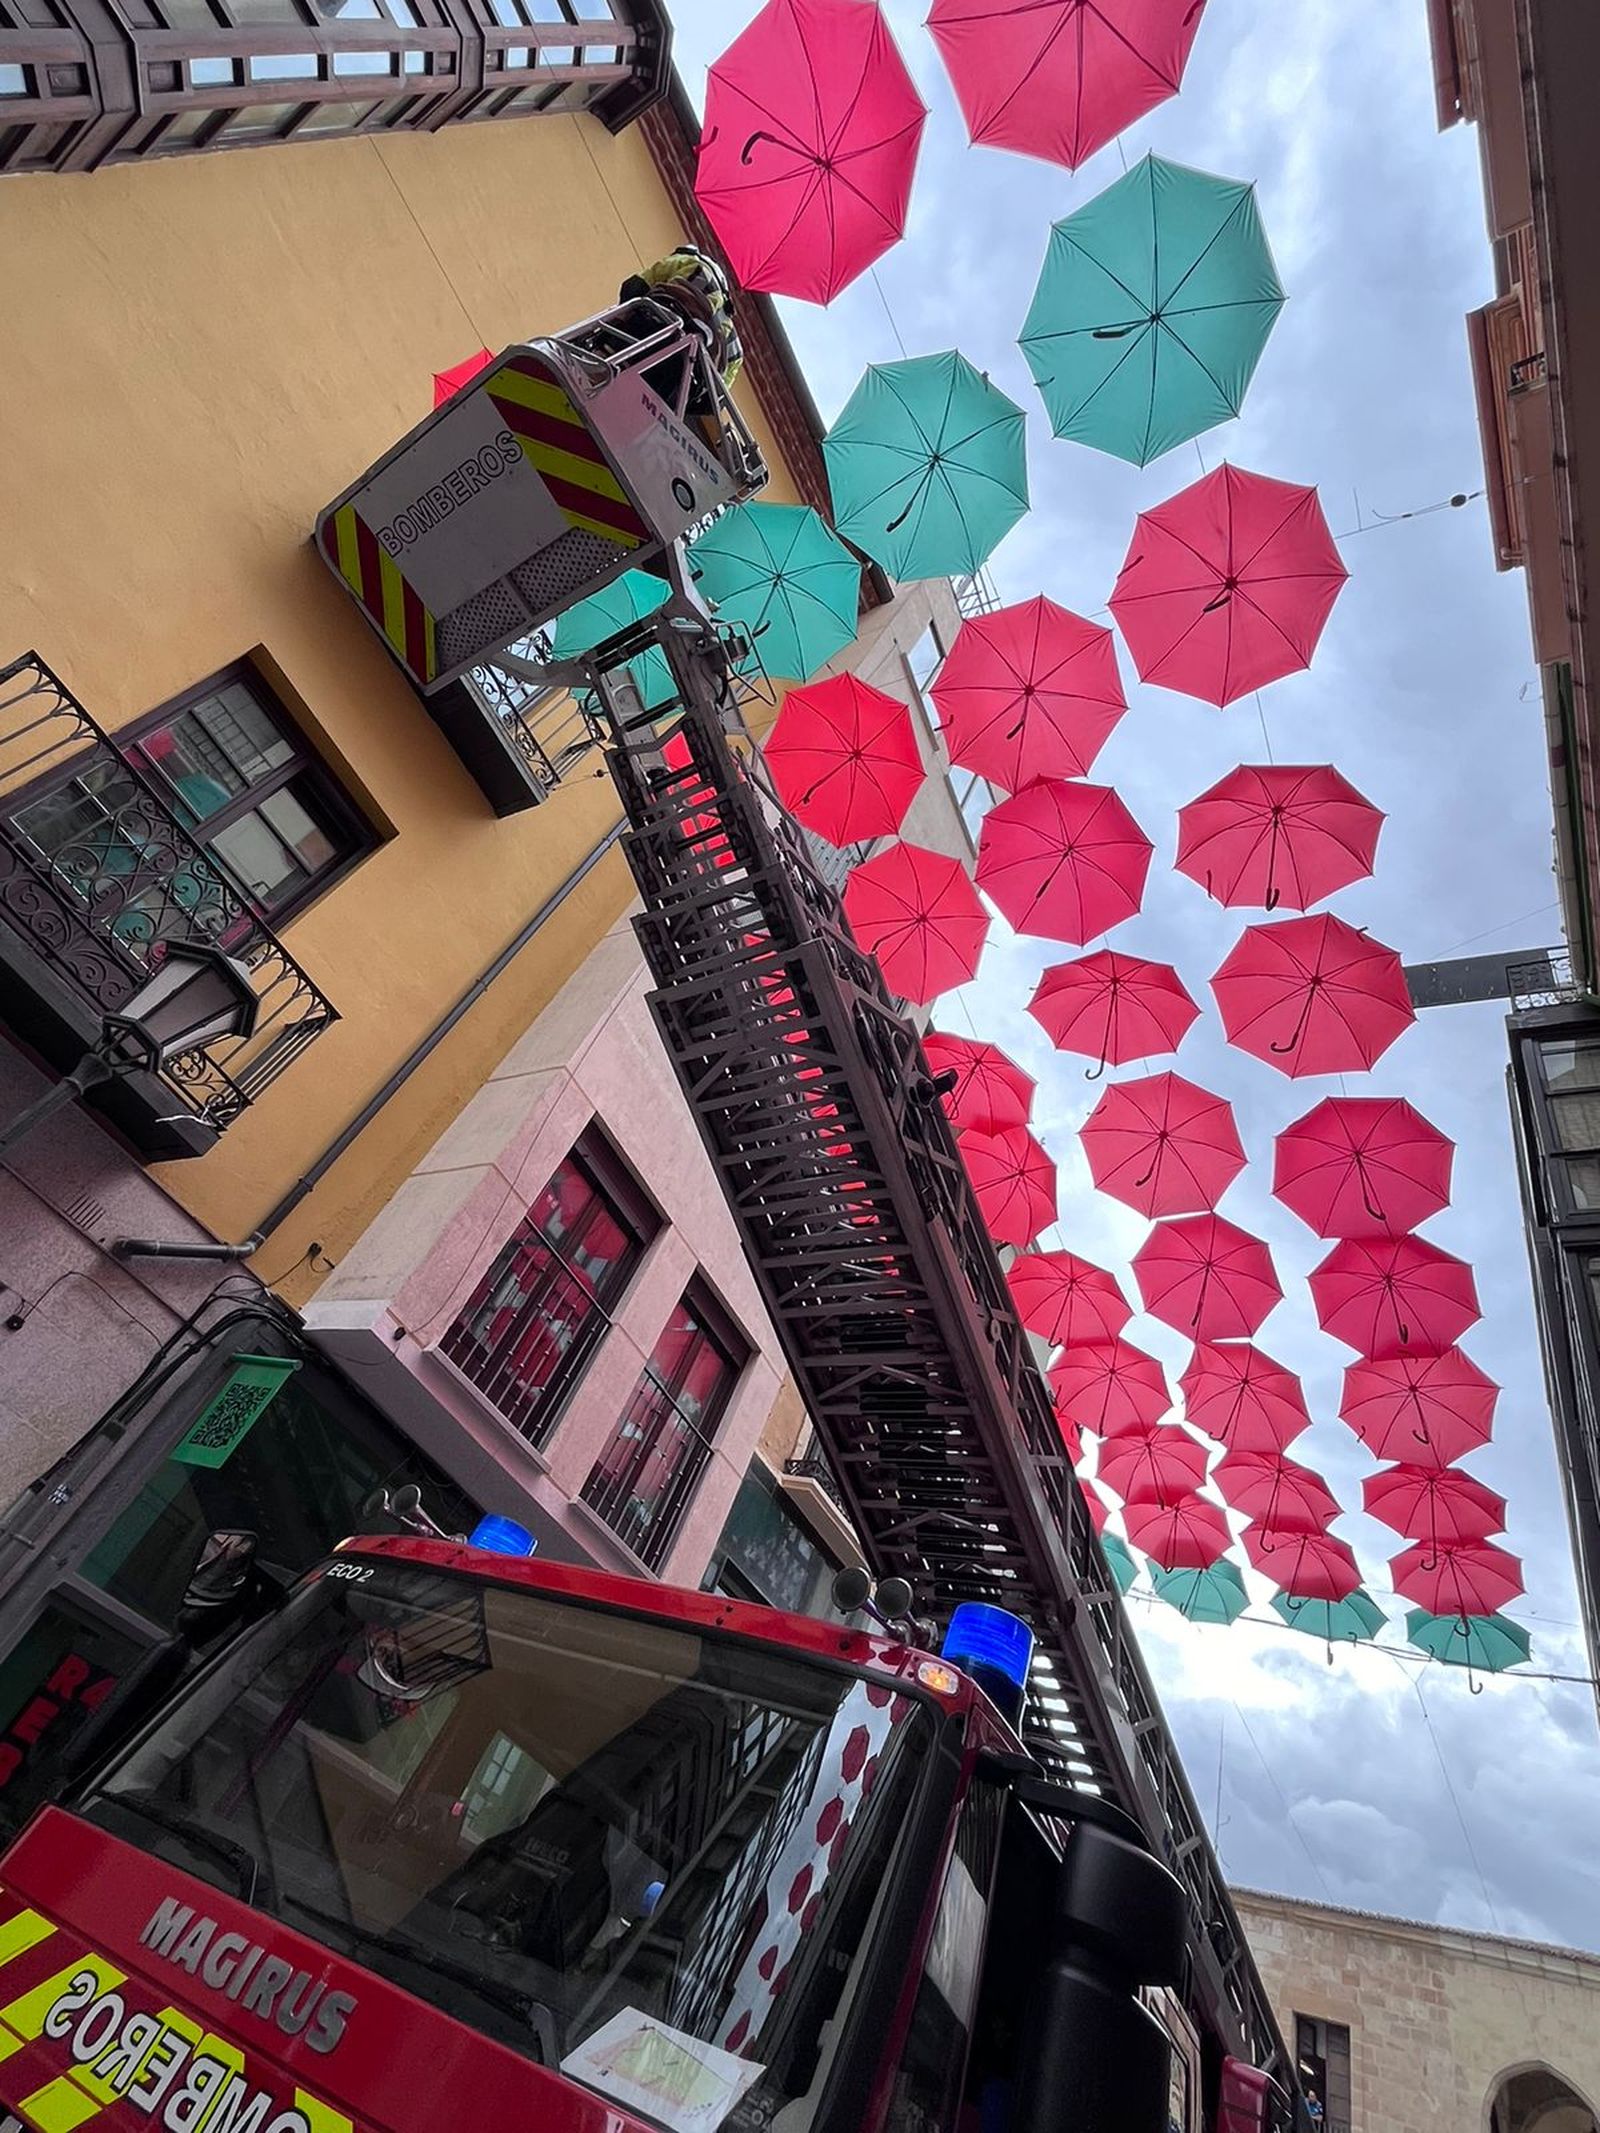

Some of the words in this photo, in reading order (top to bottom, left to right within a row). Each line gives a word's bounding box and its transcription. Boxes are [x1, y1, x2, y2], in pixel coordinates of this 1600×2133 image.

[375, 430, 524, 558] BOMBEROS
[641, 393, 720, 485] MAGIRUS
[326, 1562, 363, 1580] ECO
[356, 1568, 375, 1583] 2
[139, 1896, 358, 2055] MAGIRUS
